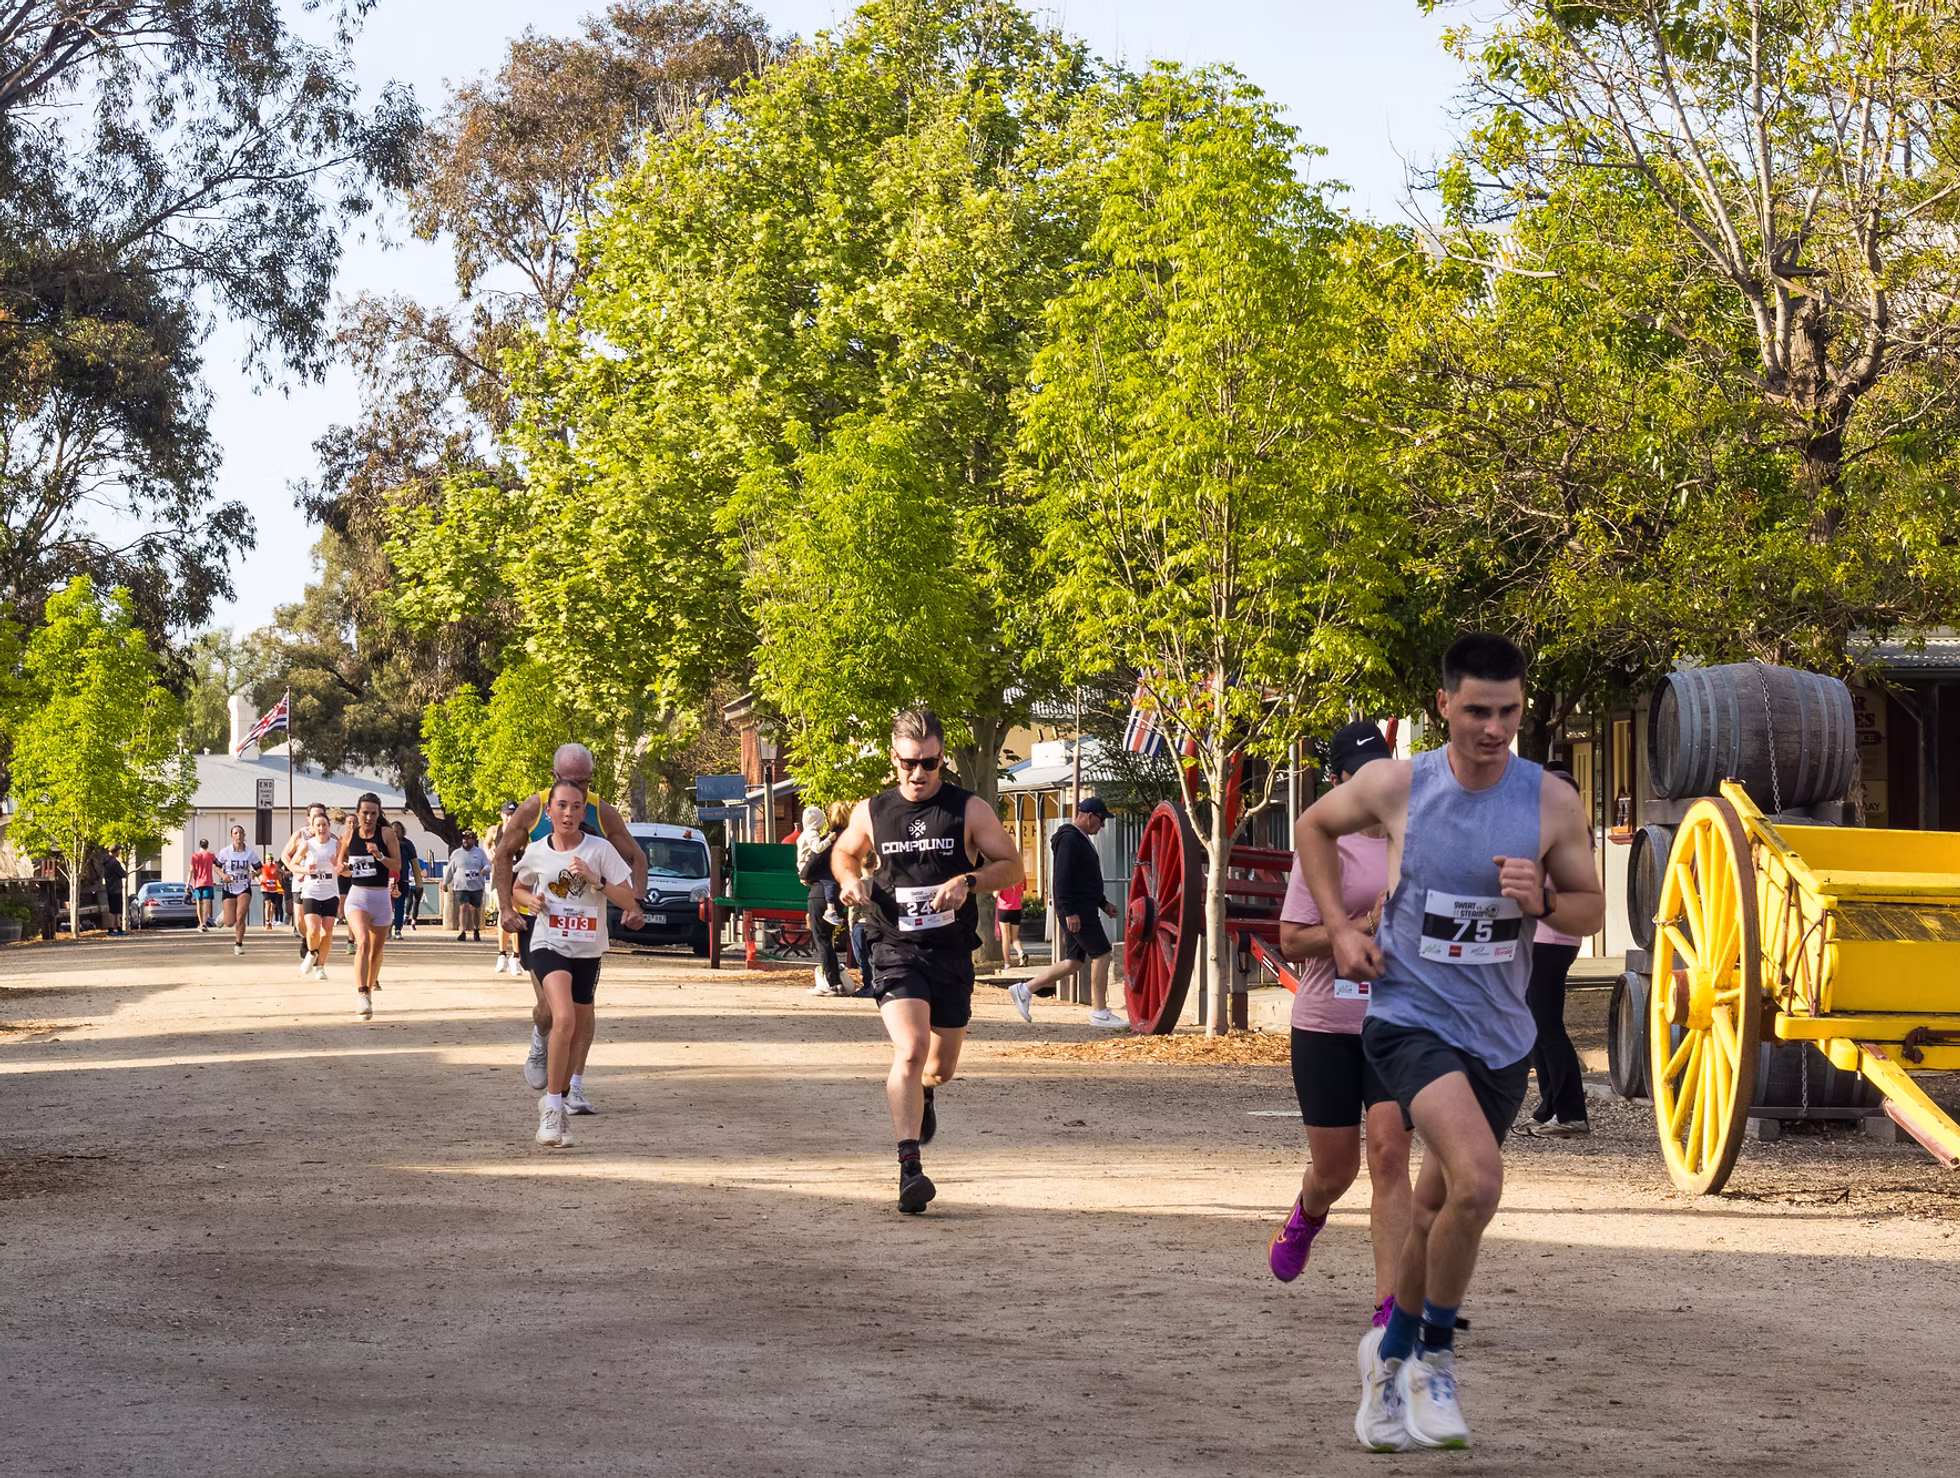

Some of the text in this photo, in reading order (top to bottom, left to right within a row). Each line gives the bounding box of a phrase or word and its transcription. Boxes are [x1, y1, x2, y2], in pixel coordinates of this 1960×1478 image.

[881, 838, 955, 855] COMPOUND
[231, 860, 249, 870] FIJI
[557, 916, 589, 930] 303
[1452, 918, 1494, 942] 75
